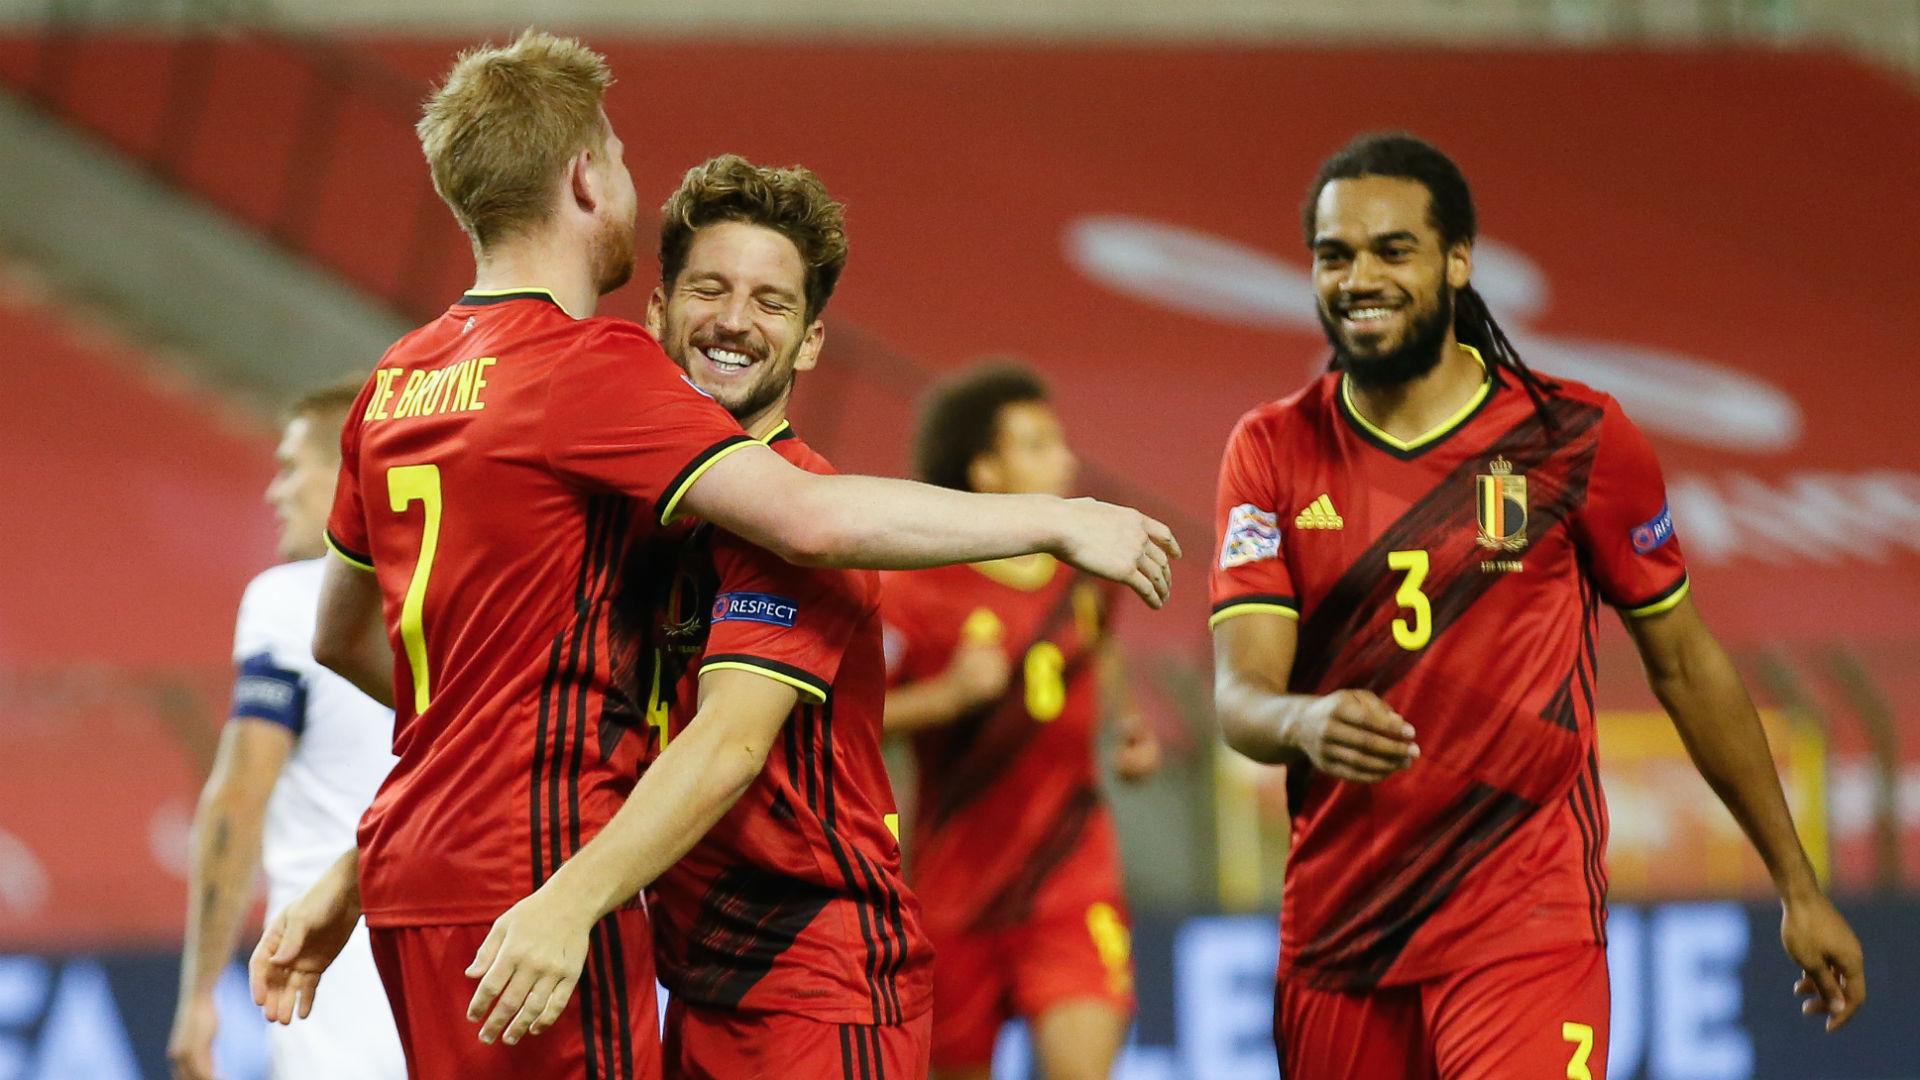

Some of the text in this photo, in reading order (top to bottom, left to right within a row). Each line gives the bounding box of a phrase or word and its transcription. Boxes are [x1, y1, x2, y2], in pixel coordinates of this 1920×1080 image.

[363, 357, 497, 421] DE BRUYNE
[387, 464, 442, 716] 7
[730, 599, 797, 620] RESPECT
[1388, 549, 1432, 652] 3
[1024, 641, 1066, 722] 6
